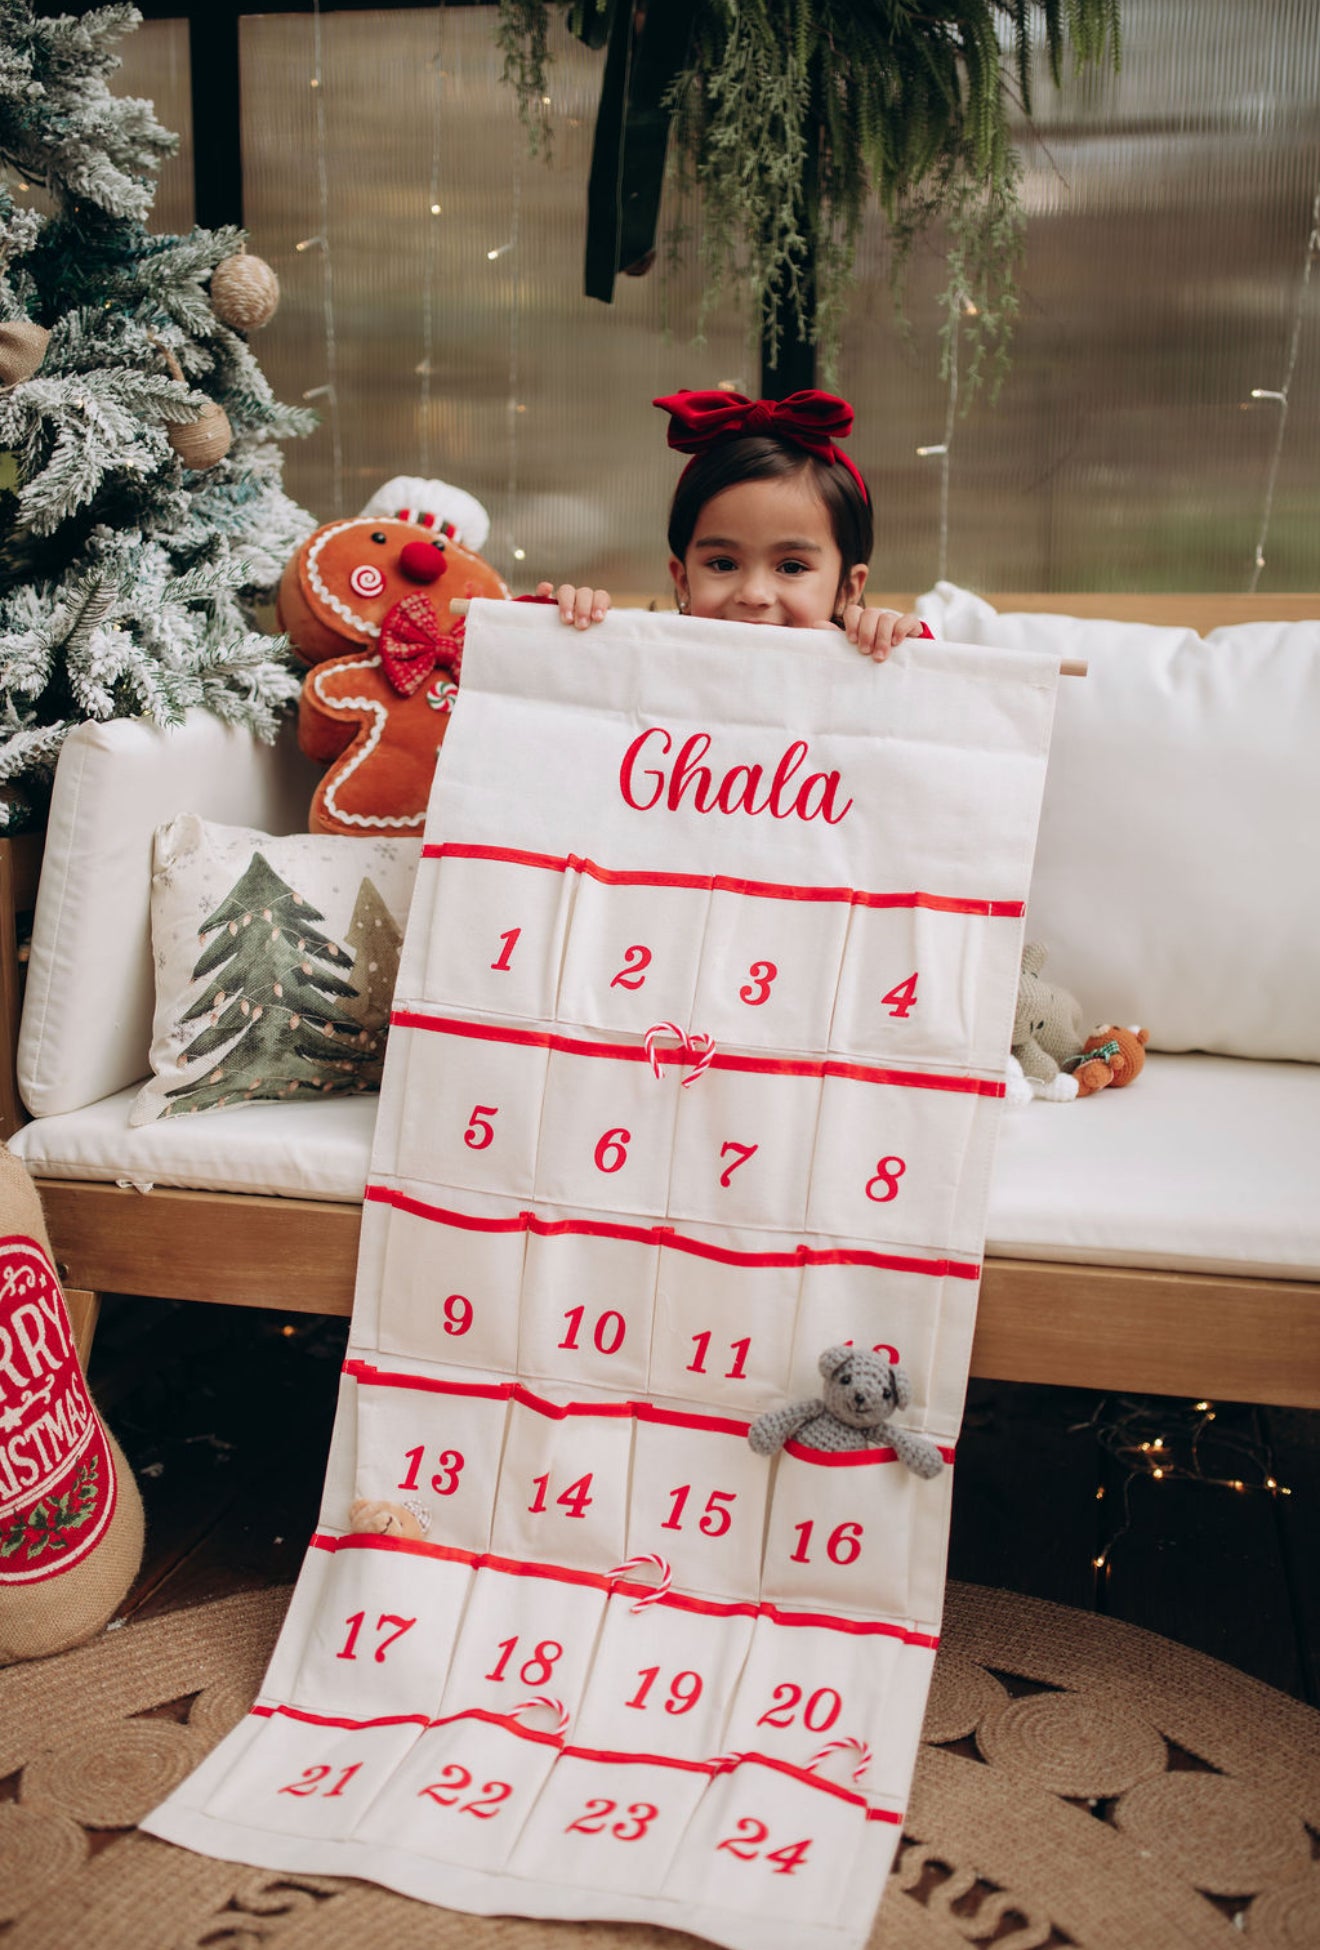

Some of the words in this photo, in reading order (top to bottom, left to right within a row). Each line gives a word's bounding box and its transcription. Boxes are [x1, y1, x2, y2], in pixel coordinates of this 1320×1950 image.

[620, 728, 854, 825] Ghala
[491, 927, 521, 971] 1
[610, 945, 653, 990] 2
[740, 961, 777, 1006] 3
[881, 972, 918, 1018] 4
[464, 1105, 498, 1150] 5
[594, 1128, 631, 1173] 6
[720, 1141, 758, 1187] 7
[865, 1156, 906, 1202] 8
[443, 1294, 473, 1336] 9
[558, 1305, 626, 1355] 10
[686, 1331, 752, 1379] 11
[398, 1445, 464, 1496] 13
[528, 1472, 593, 1518] 14
[661, 1485, 736, 1537] 15
[790, 1520, 863, 1566] 16
[336, 1611, 416, 1663] 17
[485, 1636, 563, 1686] 18
[625, 1667, 703, 1715] 19
[757, 1683, 842, 1732] 20
[280, 1763, 363, 1799] 21
[420, 1765, 512, 1819] 22
[566, 1800, 658, 1841] 23
[717, 1818, 812, 1875] 24
